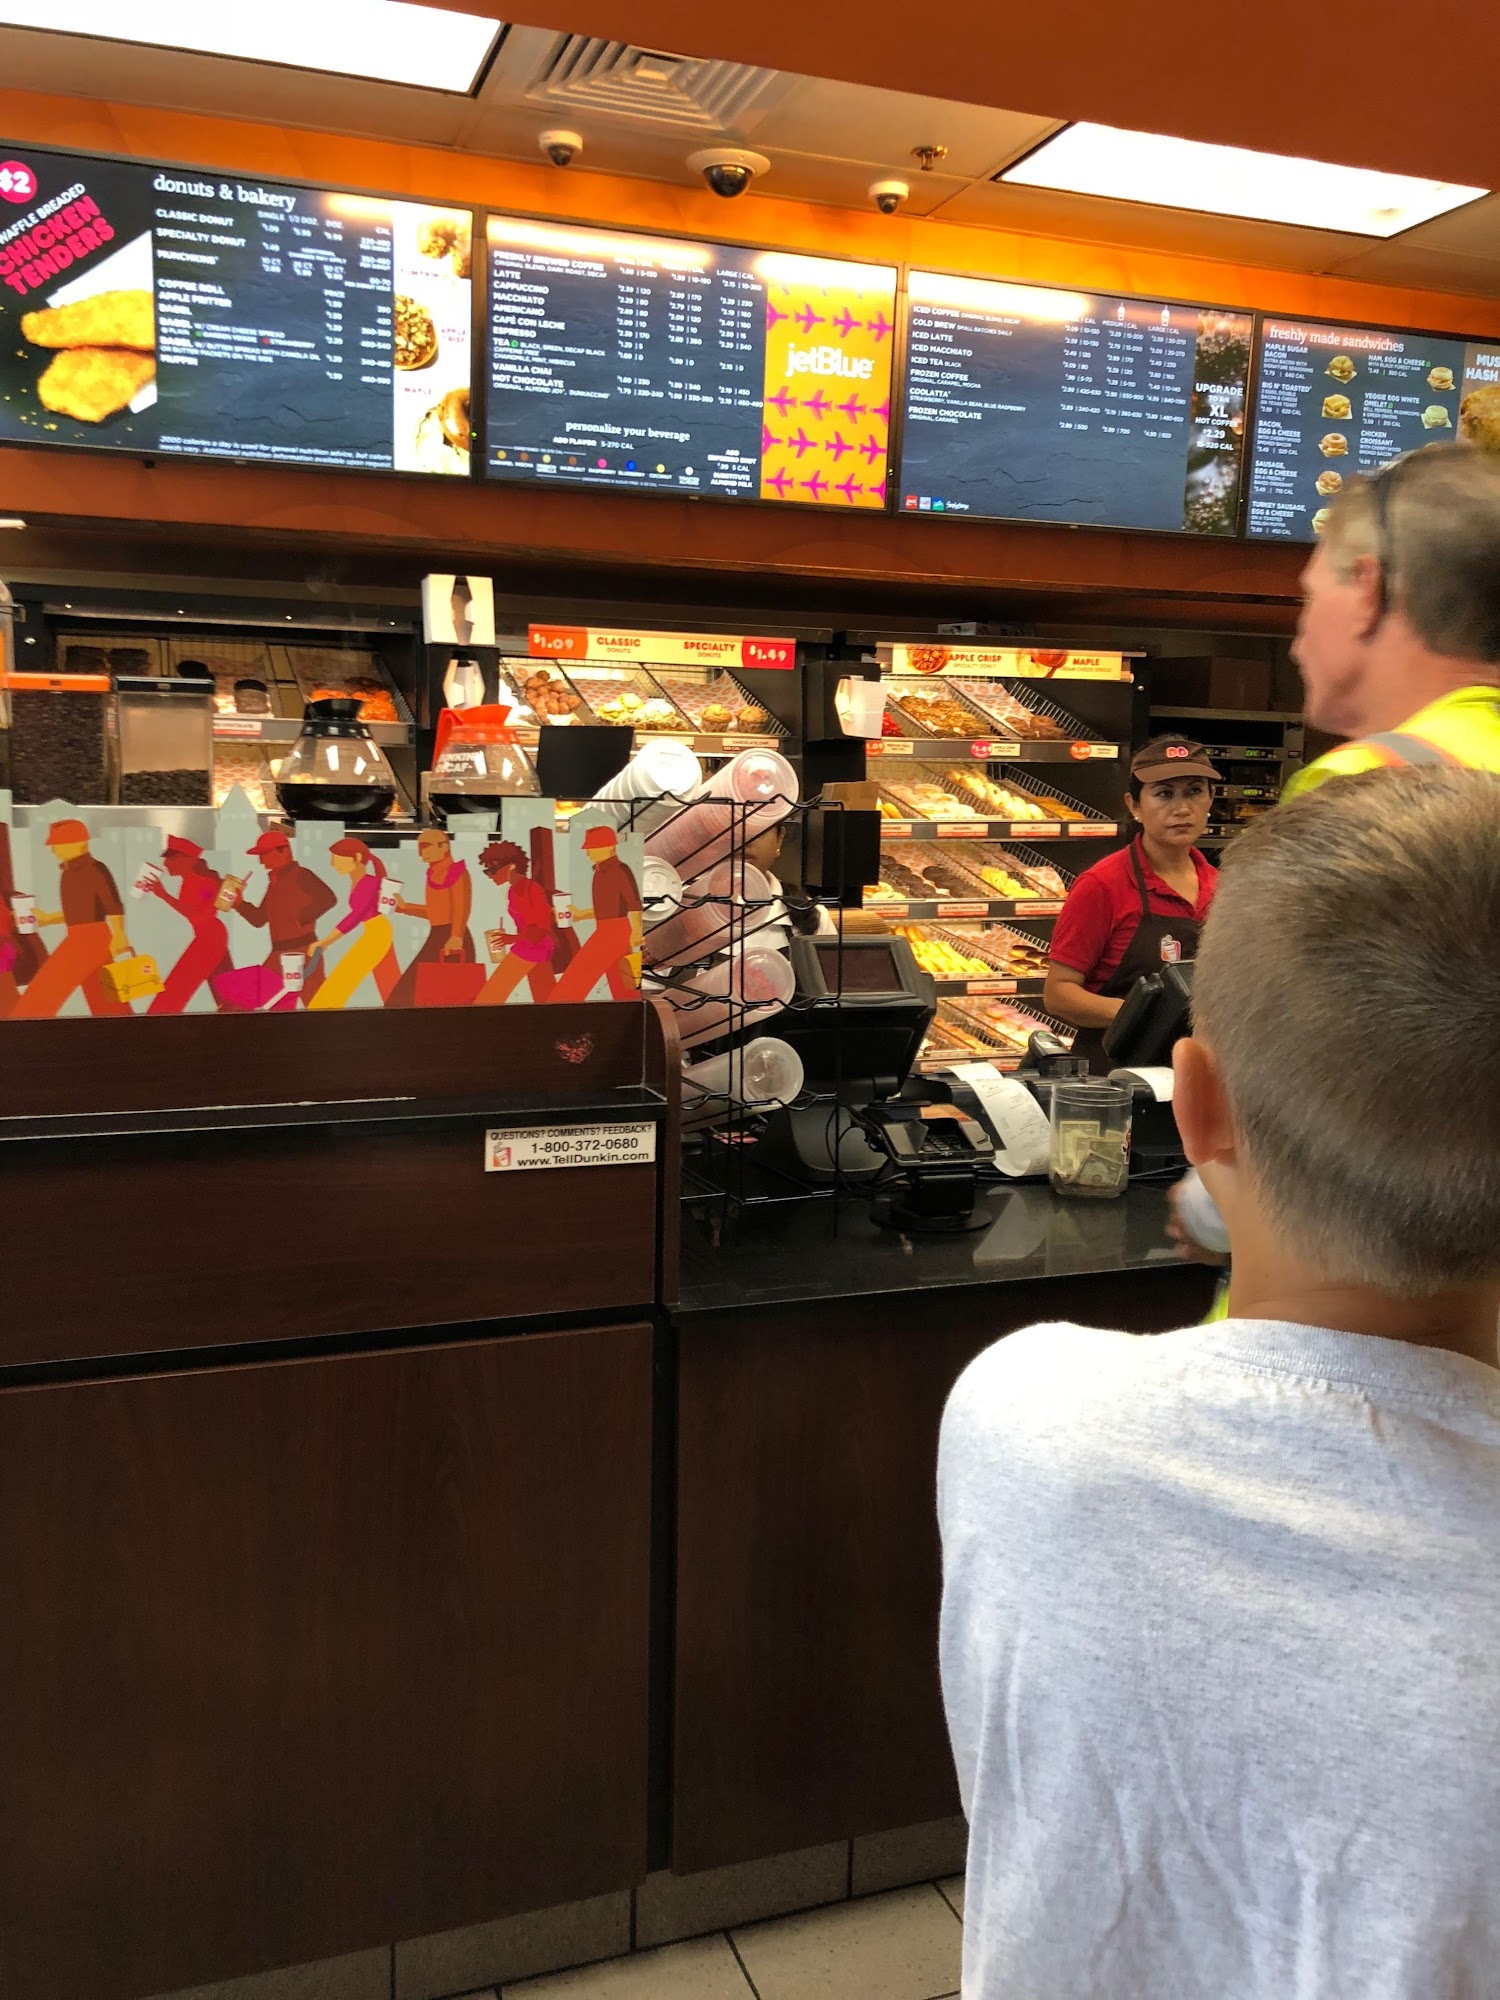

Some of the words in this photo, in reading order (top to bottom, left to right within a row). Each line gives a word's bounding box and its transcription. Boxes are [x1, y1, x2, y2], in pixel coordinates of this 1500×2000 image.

[0, 168, 31, 194] $2
[153, 174, 215, 198] donuts
[219, 184, 234, 200] &
[237, 185, 296, 213] bakery
[36, 183, 86, 219] BREADED
[155, 208, 198, 222] CLASSIC
[199, 214, 234, 227] DONUT
[0, 195, 101, 275] CHICKEN
[156, 227, 210, 242] SPECIALTY
[211, 234, 247, 247] DONUT
[5, 217, 115, 295] TENDERS
[493, 269, 521, 280] LATTE
[157, 278, 197, 292] COFFEE
[198, 283, 225, 295] ROLL
[493, 280, 549, 294] CAPPUCCINO
[158, 291, 190, 303] APPLE
[493, 292, 545, 305] MACCHIATO
[493, 303, 545, 317] AMERICANO
[913, 305, 931, 314] ICED
[931, 308, 960, 318] COFFEE
[517, 317, 537, 327] CON
[538, 319, 566, 330] LECHE
[912, 318, 933, 327] COLD
[933, 320, 956, 330] BREW
[492, 326, 537, 339] ESPRESSO
[912, 331, 929, 340] ICED
[930, 333, 954, 343] LATTE
[492, 337, 510, 347] TEA
[1269, 325, 1307, 345] freshly
[1309, 332, 1340, 346] made
[1342, 336, 1405, 354] sandwiches
[911, 343, 929, 352] ICED
[930, 346, 973, 357] MACCHIATO
[1265, 343, 1286, 352] MAPLE
[1286, 345, 1309, 354] SUGAR
[786, 343, 873, 379] jetBlue
[911, 356, 928, 365] ICED
[929, 357, 944, 366] TEA
[1264, 351, 1287, 359] BACON
[1368, 354, 1383, 362] HAM,
[1384, 356, 1397, 364] EGG
[1403, 358, 1425, 367] CHEESE
[492, 362, 530, 374] VANILLA
[531, 365, 552, 376] CHAI
[910, 368, 940, 378] FROZEN
[940, 371, 969, 381] COFFEE
[1466, 367, 1499, 382] HASH
[492, 373, 511, 384] HOT
[511, 376, 564, 388] CHOCOLATE
[1295, 372, 1306, 380] CAL
[1195, 382, 1244, 396] UPGRADE
[1261, 381, 1273, 390] BIG
[1208, 394, 1218, 402] TO
[1363, 400, 1387, 408] OMELET
[1364, 392, 1387, 401] VEGGIE
[1387, 394, 1400, 402] EGG
[1400, 396, 1420, 404] WHITE
[908, 405, 938, 416] FROZEN
[938, 408, 982, 420] CHOCOLATE
[1208, 404, 1229, 418] XL
[1292, 408, 1302, 416] CAL
[1194, 416, 1211, 425] HOT
[1210, 418, 1239, 428] COFFEE
[1258, 419, 1283, 429] BACON,
[565, 422, 622, 435] personalize
[624, 426, 646, 438] your
[648, 427, 690, 443] beverage
[1202, 428, 1226, 439] $2.29
[1257, 427, 1272, 436] EGG
[1277, 430, 1301, 438] CHEESE
[1360, 430, 1387, 438] CHICKEN
[620, 442, 634, 450] CAL
[1220, 442, 1234, 451] CAL
[1360, 437, 1394, 446] CROISSANT
[1255, 460, 1286, 470] SAUSAGE,
[1254, 468, 1268, 476] EGG
[1274, 469, 1298, 478] CHEESE
[1252, 500, 1276, 509] TURKEY
[1277, 502, 1306, 512] SAUSAGE,
[1251, 508, 1265, 517] EGG
[1270, 510, 1294, 518] CHEESE
[533, 633, 575, 651] $1.09
[597, 636, 641, 648] CLASSIC
[607, 646, 632, 654] DONUTS
[683, 641, 736, 652] SPECIALTY
[749, 645, 787, 662] $1.49
[697, 651, 722, 659] DONUTS
[949, 653, 975, 662] APPLE
[977, 655, 1002, 663] CRISP
[1072, 658, 1100, 666] MAPLE
[1166, 746, 1189, 758] DD
[381, 896, 397, 907] DD
[19, 915, 37, 925] DD
[558, 911, 572, 920] DD
[285, 972, 302, 980] DD
[490, 1129, 546, 1141] QUESTIONS?
[548, 1126, 601, 1138] COMMENTS?
[602, 1124, 652, 1136] FEEDBACK?
[531, 1137, 639, 1154] 1-800-372-0680
[517, 1151, 650, 1167] www.TellDunkin.com
